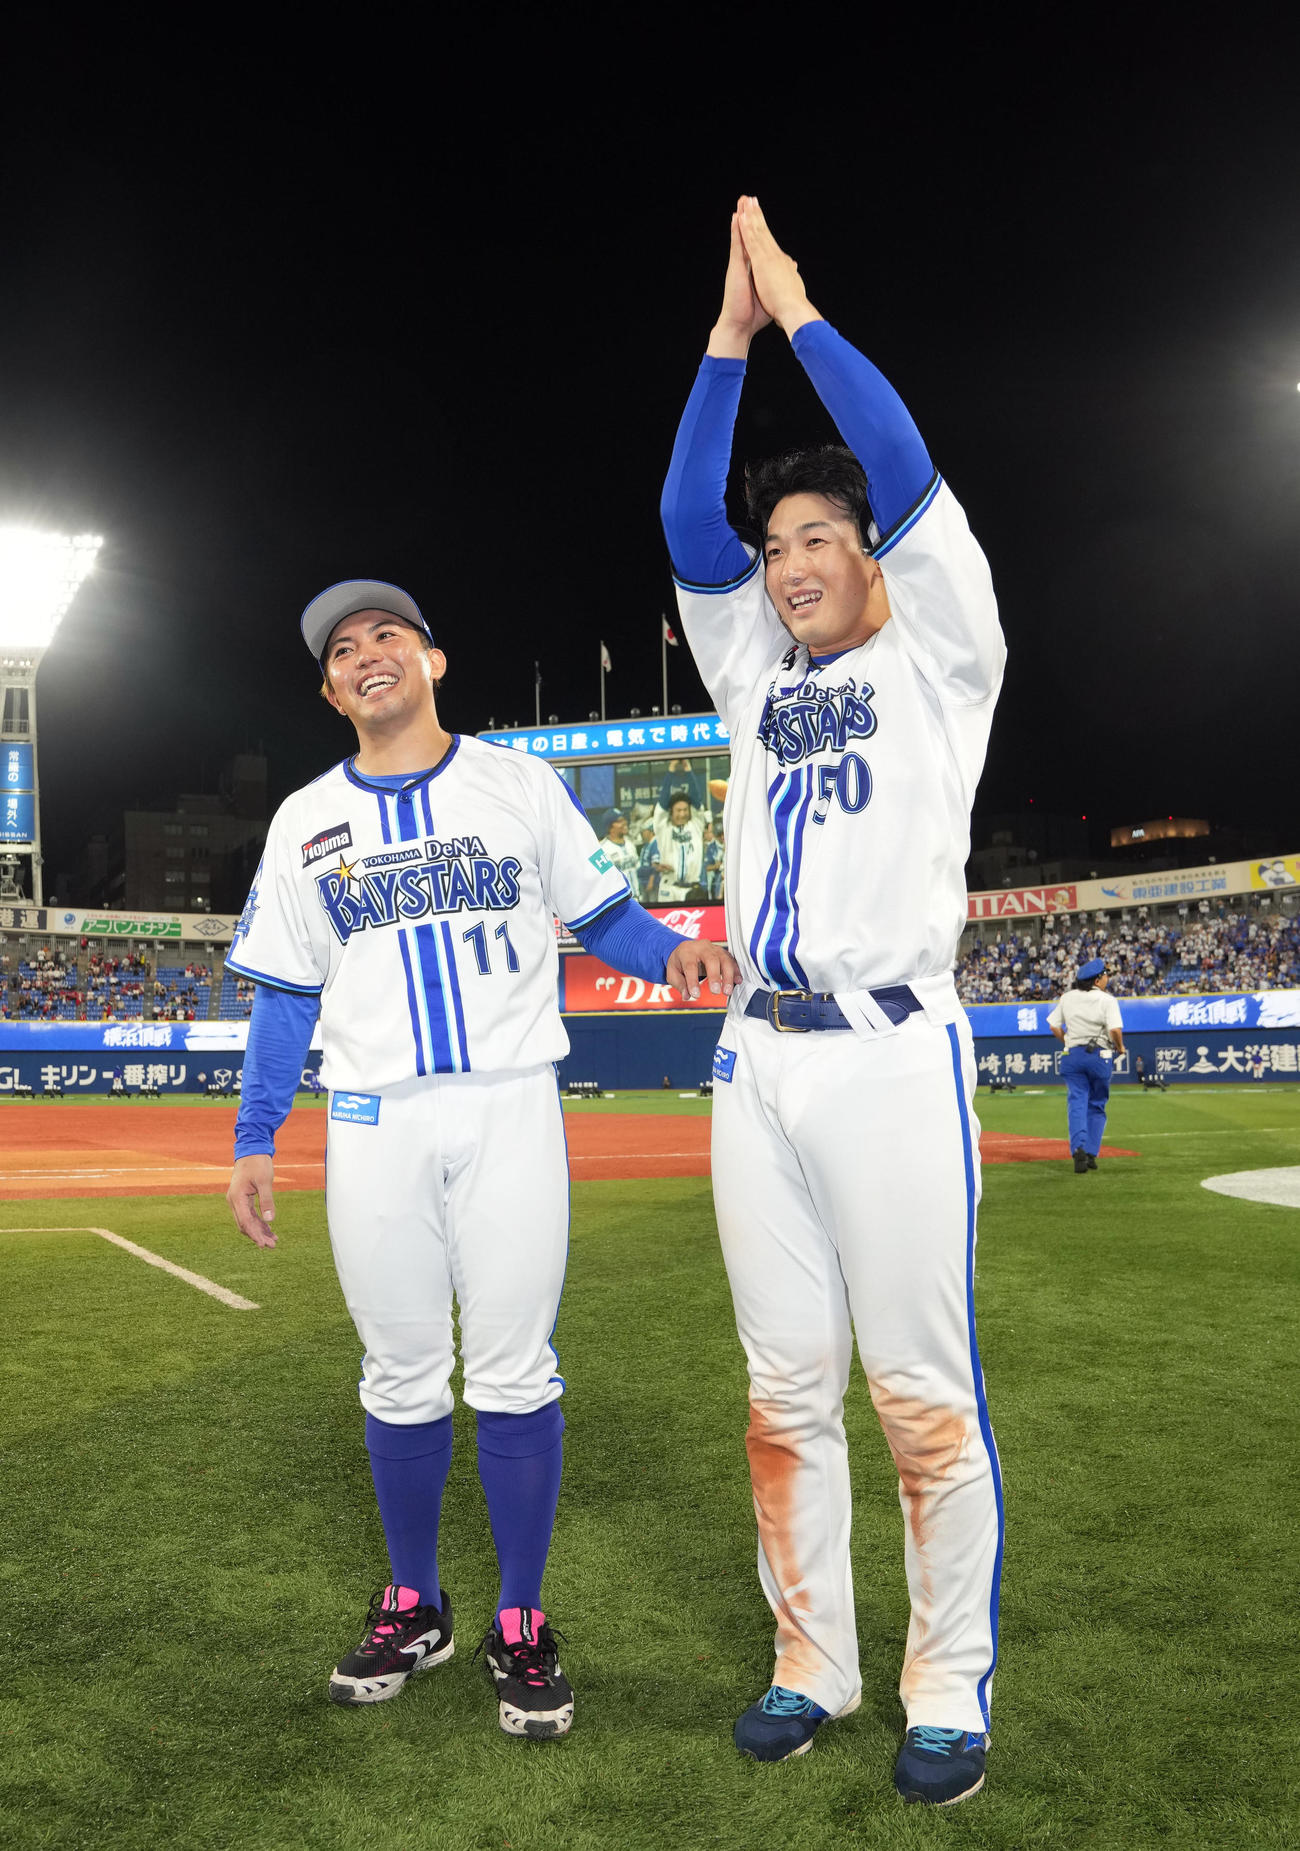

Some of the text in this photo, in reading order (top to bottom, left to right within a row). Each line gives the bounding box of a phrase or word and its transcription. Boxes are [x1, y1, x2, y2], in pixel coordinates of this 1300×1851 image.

[812, 751, 873, 825] 50
[363, 836, 487, 868] YOKOHAMA DeNA
[315, 857, 522, 945] BAYSTARS
[463, 921, 520, 974] 11
[978, 1052, 1053, 1076] 崎陽軒
